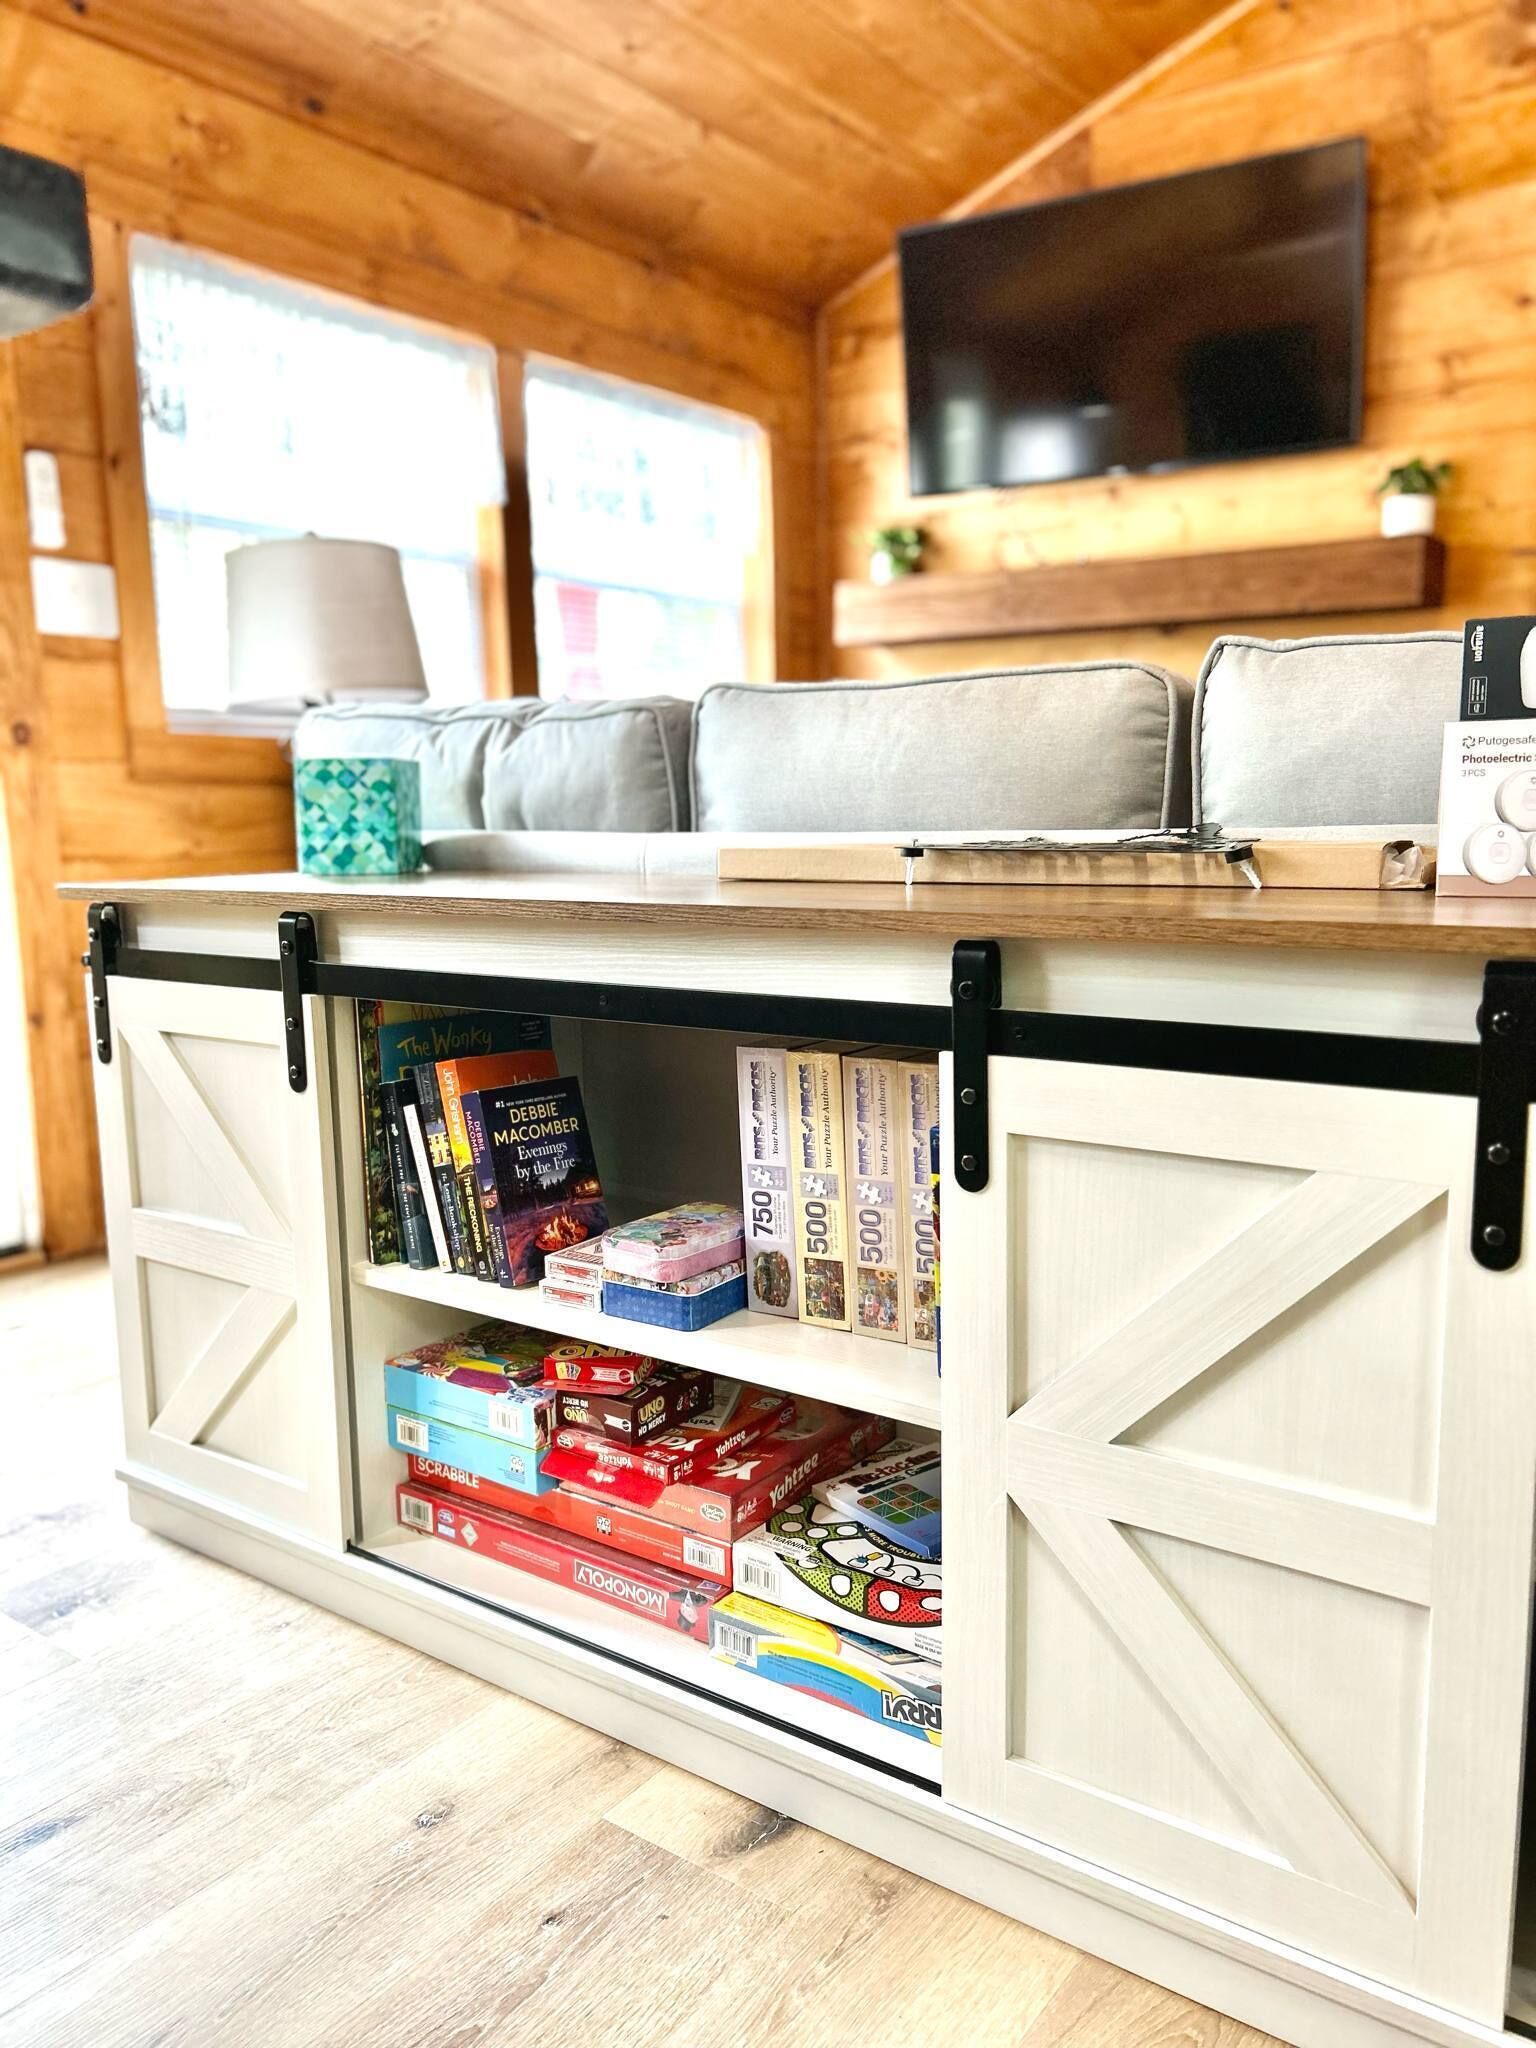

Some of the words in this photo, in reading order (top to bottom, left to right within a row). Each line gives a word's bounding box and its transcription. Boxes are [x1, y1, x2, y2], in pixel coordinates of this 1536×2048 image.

[1472, 625, 1484, 662] amazon
[1478, 734, 1536, 747] Putogesafe
[1462, 752, 1532, 764] Photoelectric
[1468, 769, 1486, 777] PCS
[396, 1035, 431, 1059] The
[443, 1068, 455, 1097] John
[495, 1100, 505, 1109] #1
[509, 1101, 559, 1124] DEBBIE
[465, 1111, 481, 1164] MACOMBER
[474, 1120, 486, 1152] DEBBIE
[493, 1117, 580, 1147] MACOMBER
[770, 1110, 778, 1136] Puzzle
[823, 1115, 831, 1146] Puzzle
[879, 1121, 887, 1153] Puzzle
[516, 1140, 568, 1160] Evenings
[824, 1148, 832, 1169] Your
[515, 1164, 530, 1182] by
[533, 1160, 552, 1175] the
[553, 1156, 577, 1170] Fire
[880, 1158, 888, 1176] Your
[463, 1175, 473, 1196] THE
[442, 1183, 452, 1202] Lost
[448, 1205, 460, 1251] Bookshop
[467, 1196, 483, 1253] RECKONING
[752, 1190, 773, 1237] 750
[805, 1201, 828, 1254] 500
[859, 1209, 883, 1264] 500
[915, 1219, 935, 1274] 500
[564, 1406, 589, 1424] UNO
[638, 1395, 665, 1425] UNO
[638, 1424, 647, 1437] NO
[648, 1412, 666, 1431] MERCY
[715, 1430, 746, 1459] Yahtzee
[418, 1456, 480, 1488] SCRABBLE
[769, 1452, 819, 1508] Yahtzee
[772, 1535, 812, 1552] WARNING
[868, 1532, 888, 1546] MORE
[577, 1566, 663, 1612] MONOPOLY
[884, 1692, 942, 1731] RRY!
